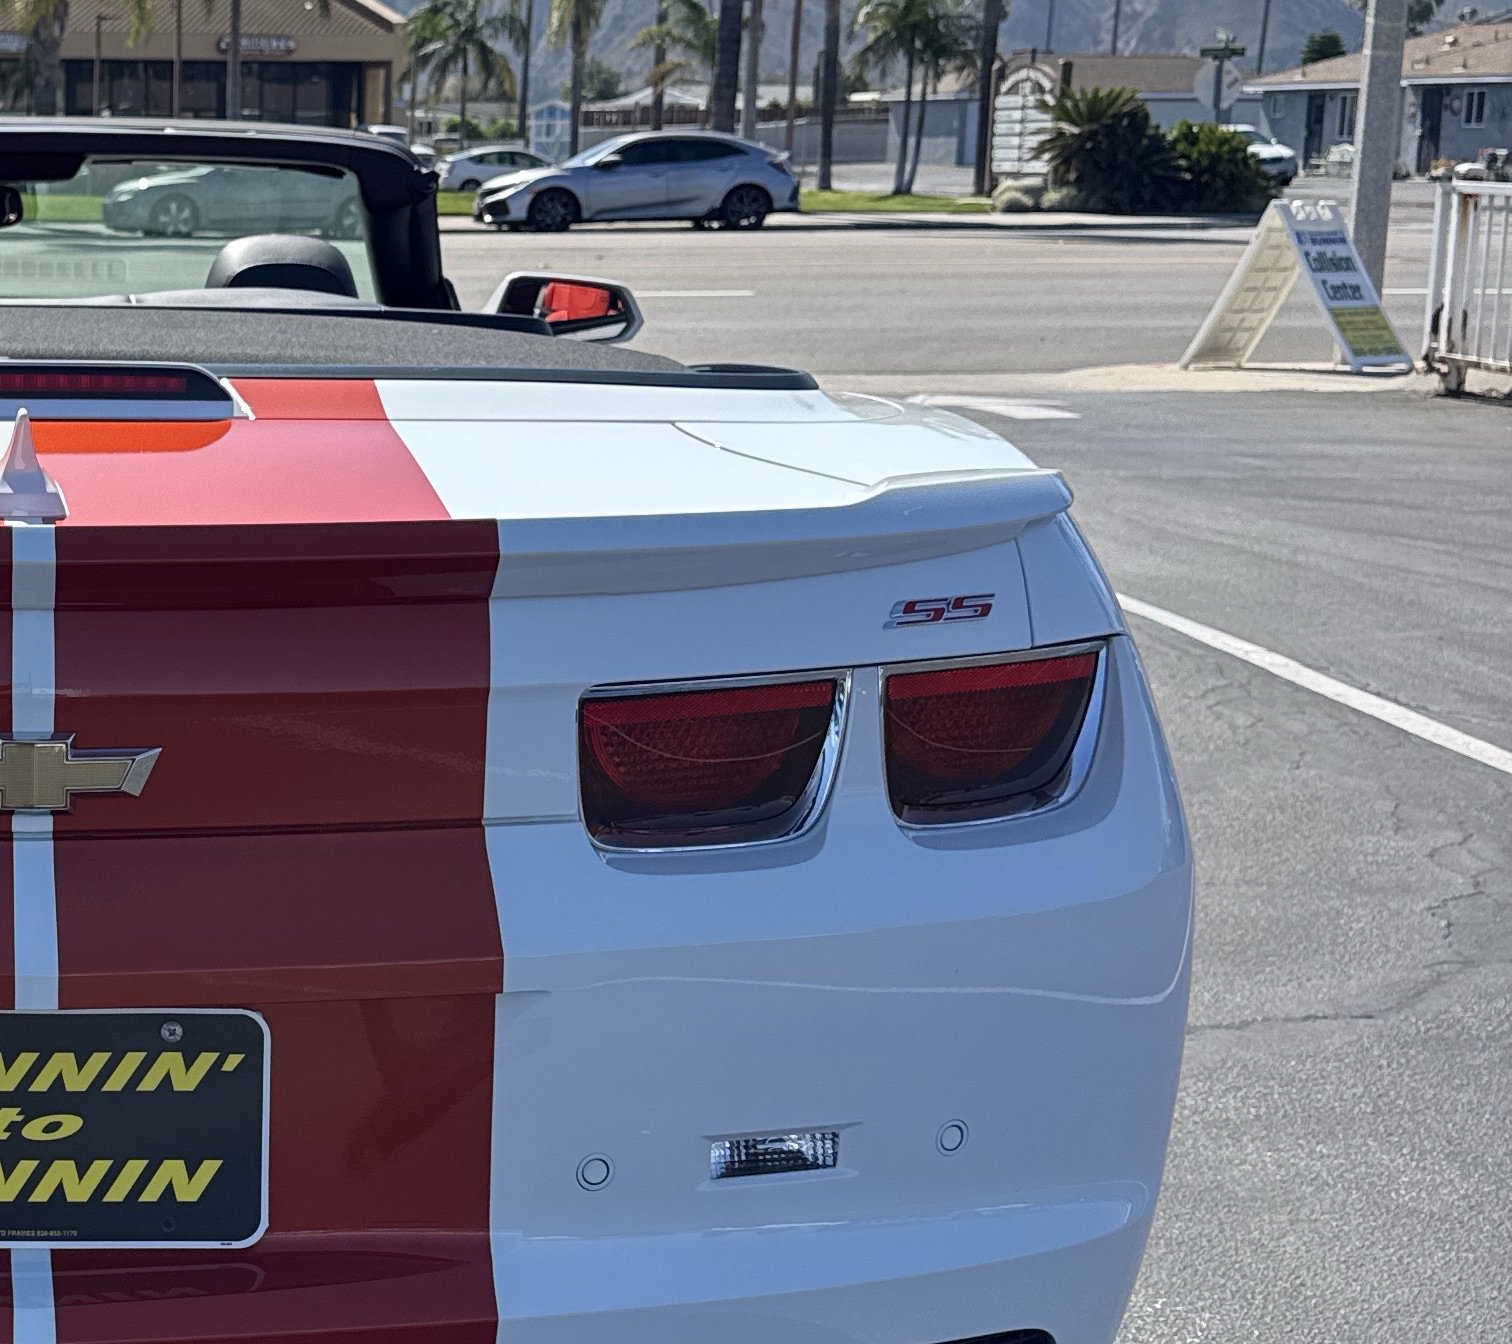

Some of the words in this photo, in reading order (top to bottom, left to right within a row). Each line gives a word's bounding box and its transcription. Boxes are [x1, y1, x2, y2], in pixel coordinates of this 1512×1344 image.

[1303, 250, 1358, 273] Collision
[1320, 278, 1364, 301] Center
[882, 593, 996, 630] SS
